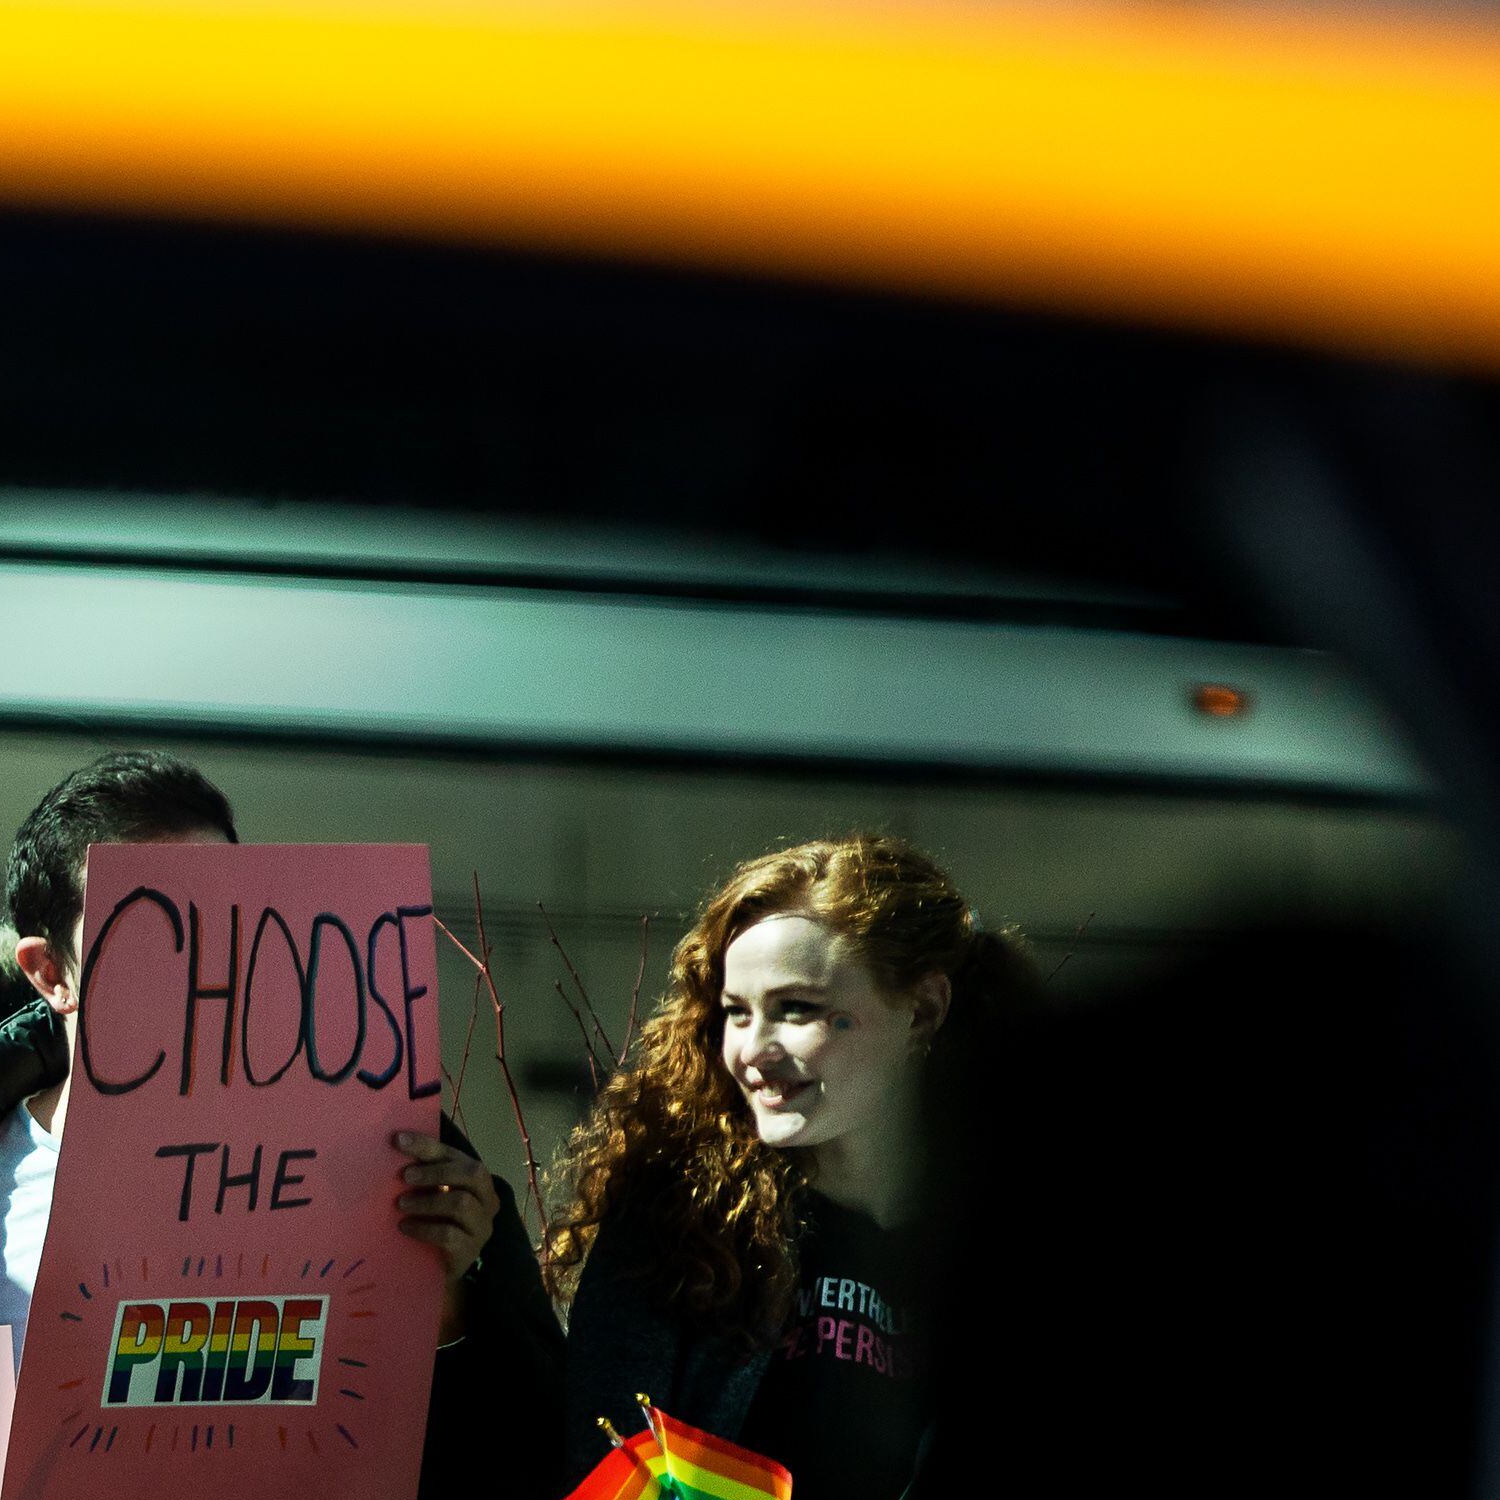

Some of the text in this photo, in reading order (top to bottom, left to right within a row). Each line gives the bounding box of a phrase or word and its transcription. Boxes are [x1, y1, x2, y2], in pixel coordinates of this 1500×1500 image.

[80, 886, 441, 1099] CHOOSE
[155, 1143, 317, 1221] THE
[107, 1301, 321, 1404] PRIDE
